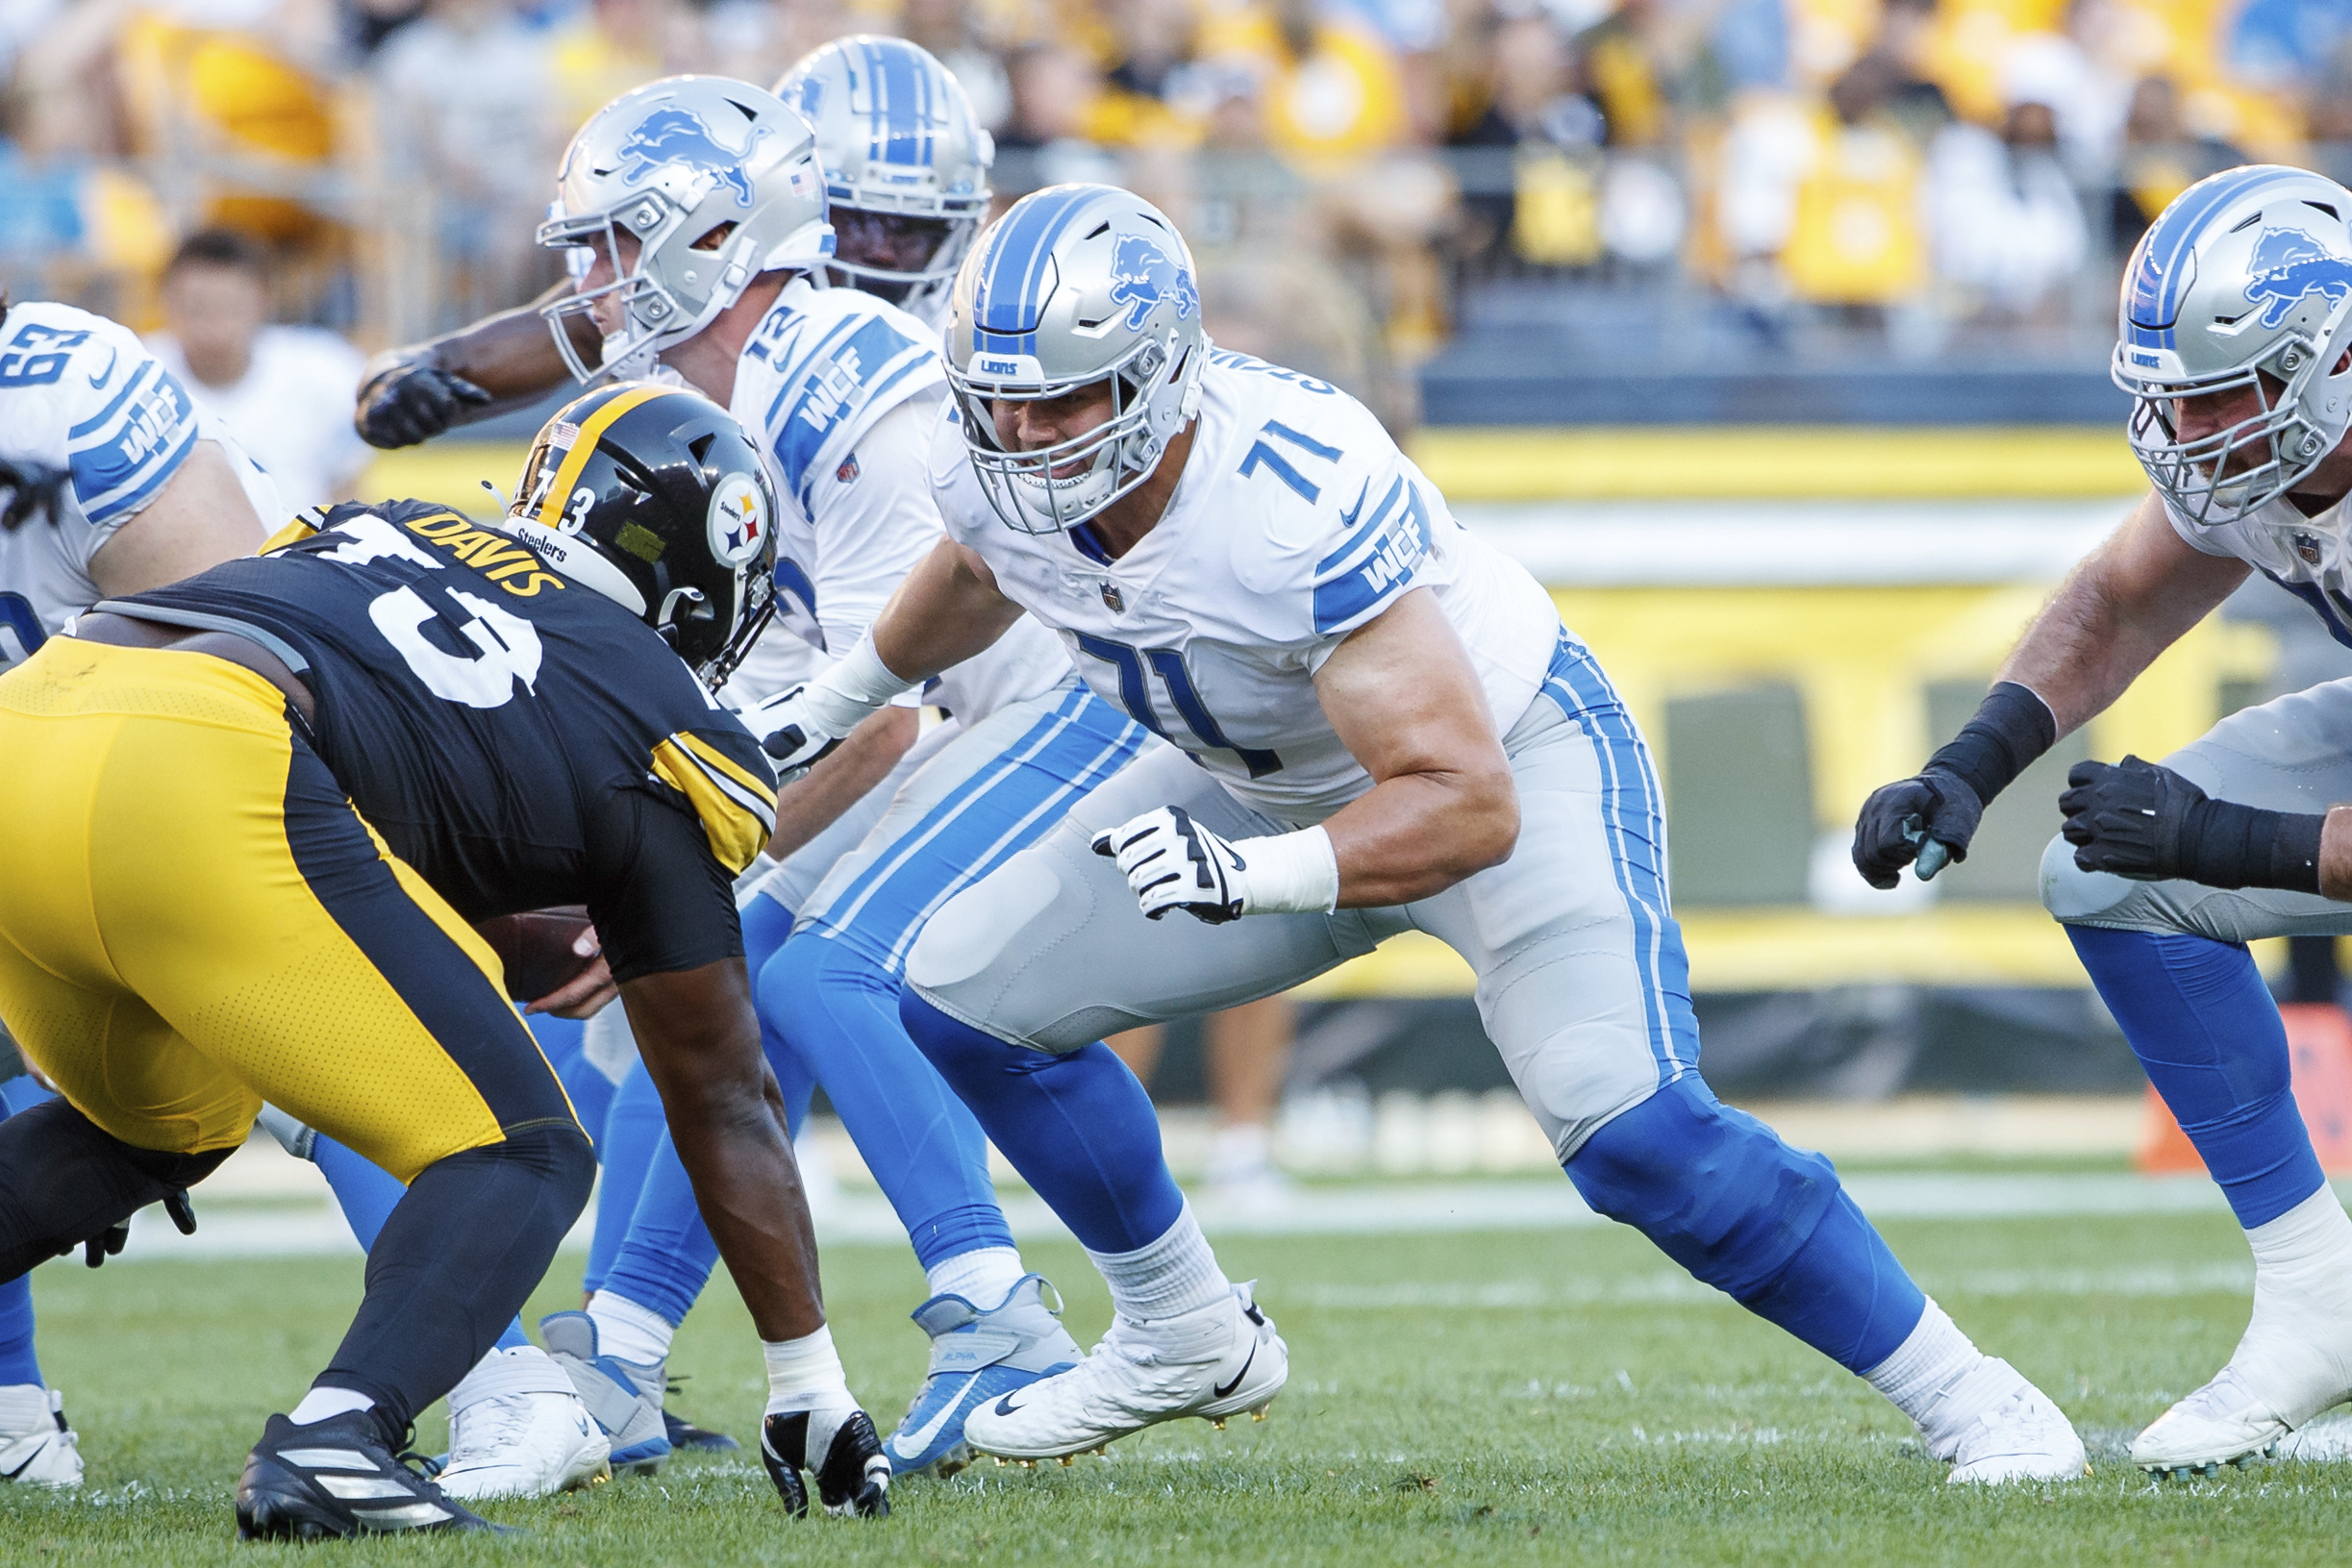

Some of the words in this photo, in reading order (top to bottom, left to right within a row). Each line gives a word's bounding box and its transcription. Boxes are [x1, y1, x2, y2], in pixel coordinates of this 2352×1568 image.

[0, 323, 97, 389] 63
[744, 306, 809, 363] 12
[119, 383, 180, 465] WCF
[798, 345, 863, 434] WCF
[1237, 418, 1345, 507] 71
[405, 511, 566, 597] DAVIS
[517, 528, 568, 563] Steelers
[1359, 510, 1423, 594] WCF
[1073, 628, 1285, 780] 71
